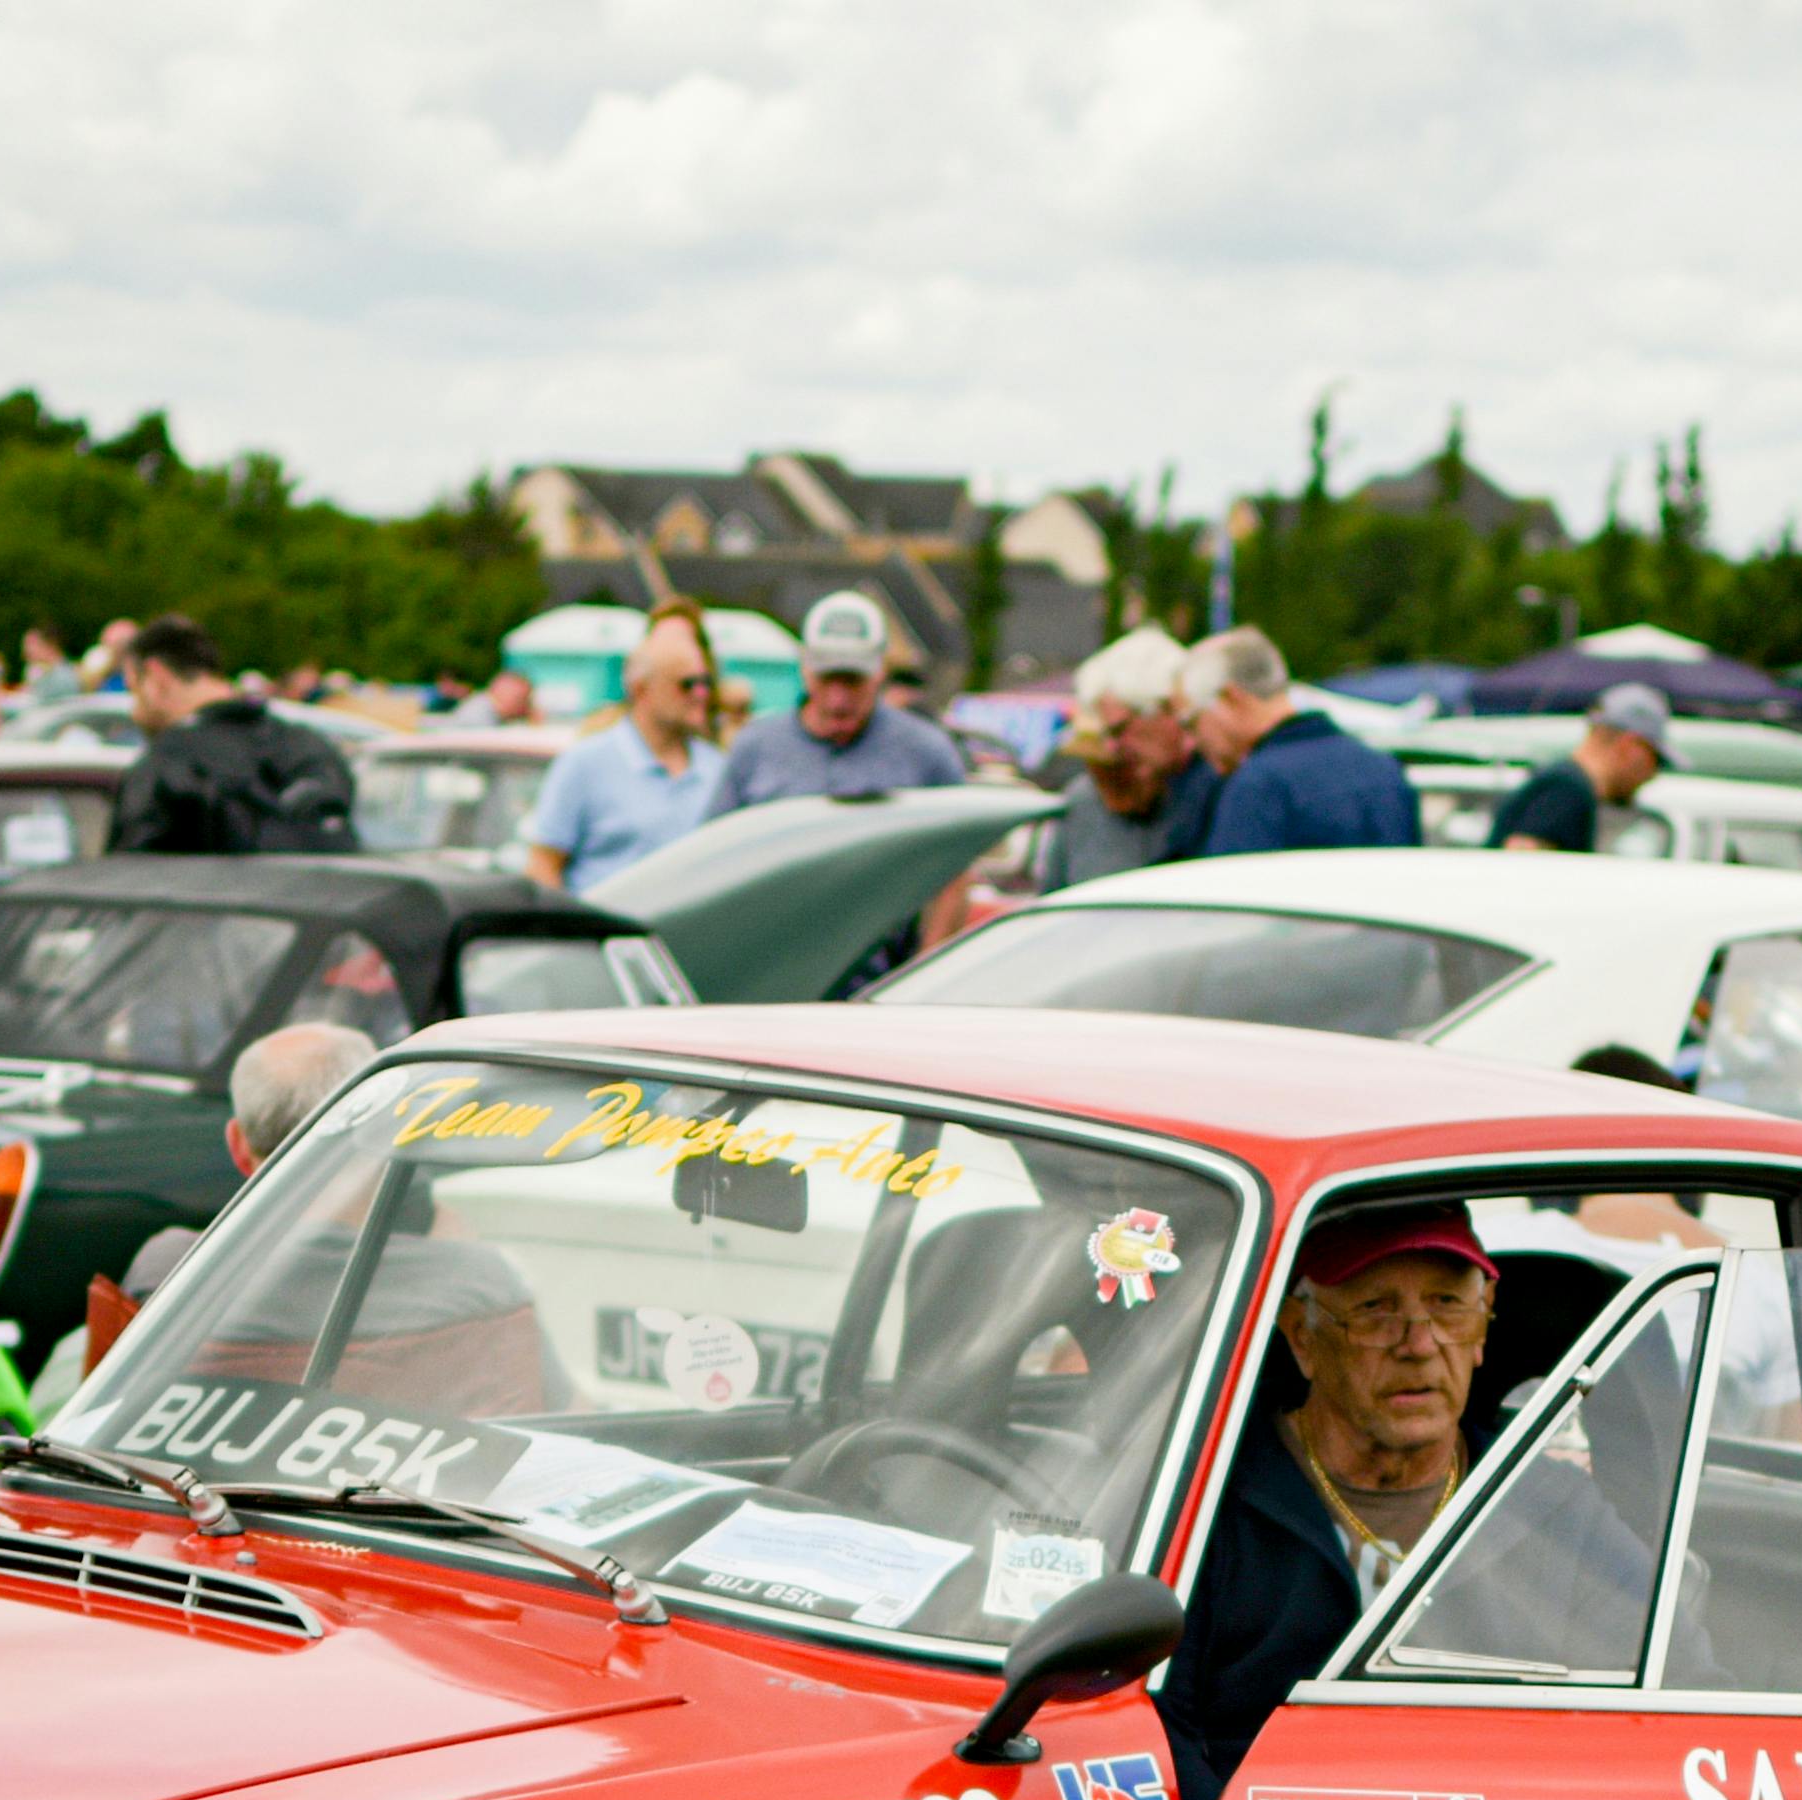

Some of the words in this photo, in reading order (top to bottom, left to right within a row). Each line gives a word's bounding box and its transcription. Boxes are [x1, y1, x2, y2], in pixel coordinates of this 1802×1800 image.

[393, 1077, 553, 1147] Team
[543, 1081, 797, 1176] Pompeo
[789, 1121, 965, 1199] Auto
[114, 1383, 305, 1463] BUJ
[275, 1406, 479, 1498] 85K
[700, 1571, 766, 1596] BUJ
[761, 1581, 823, 1610] 85K
